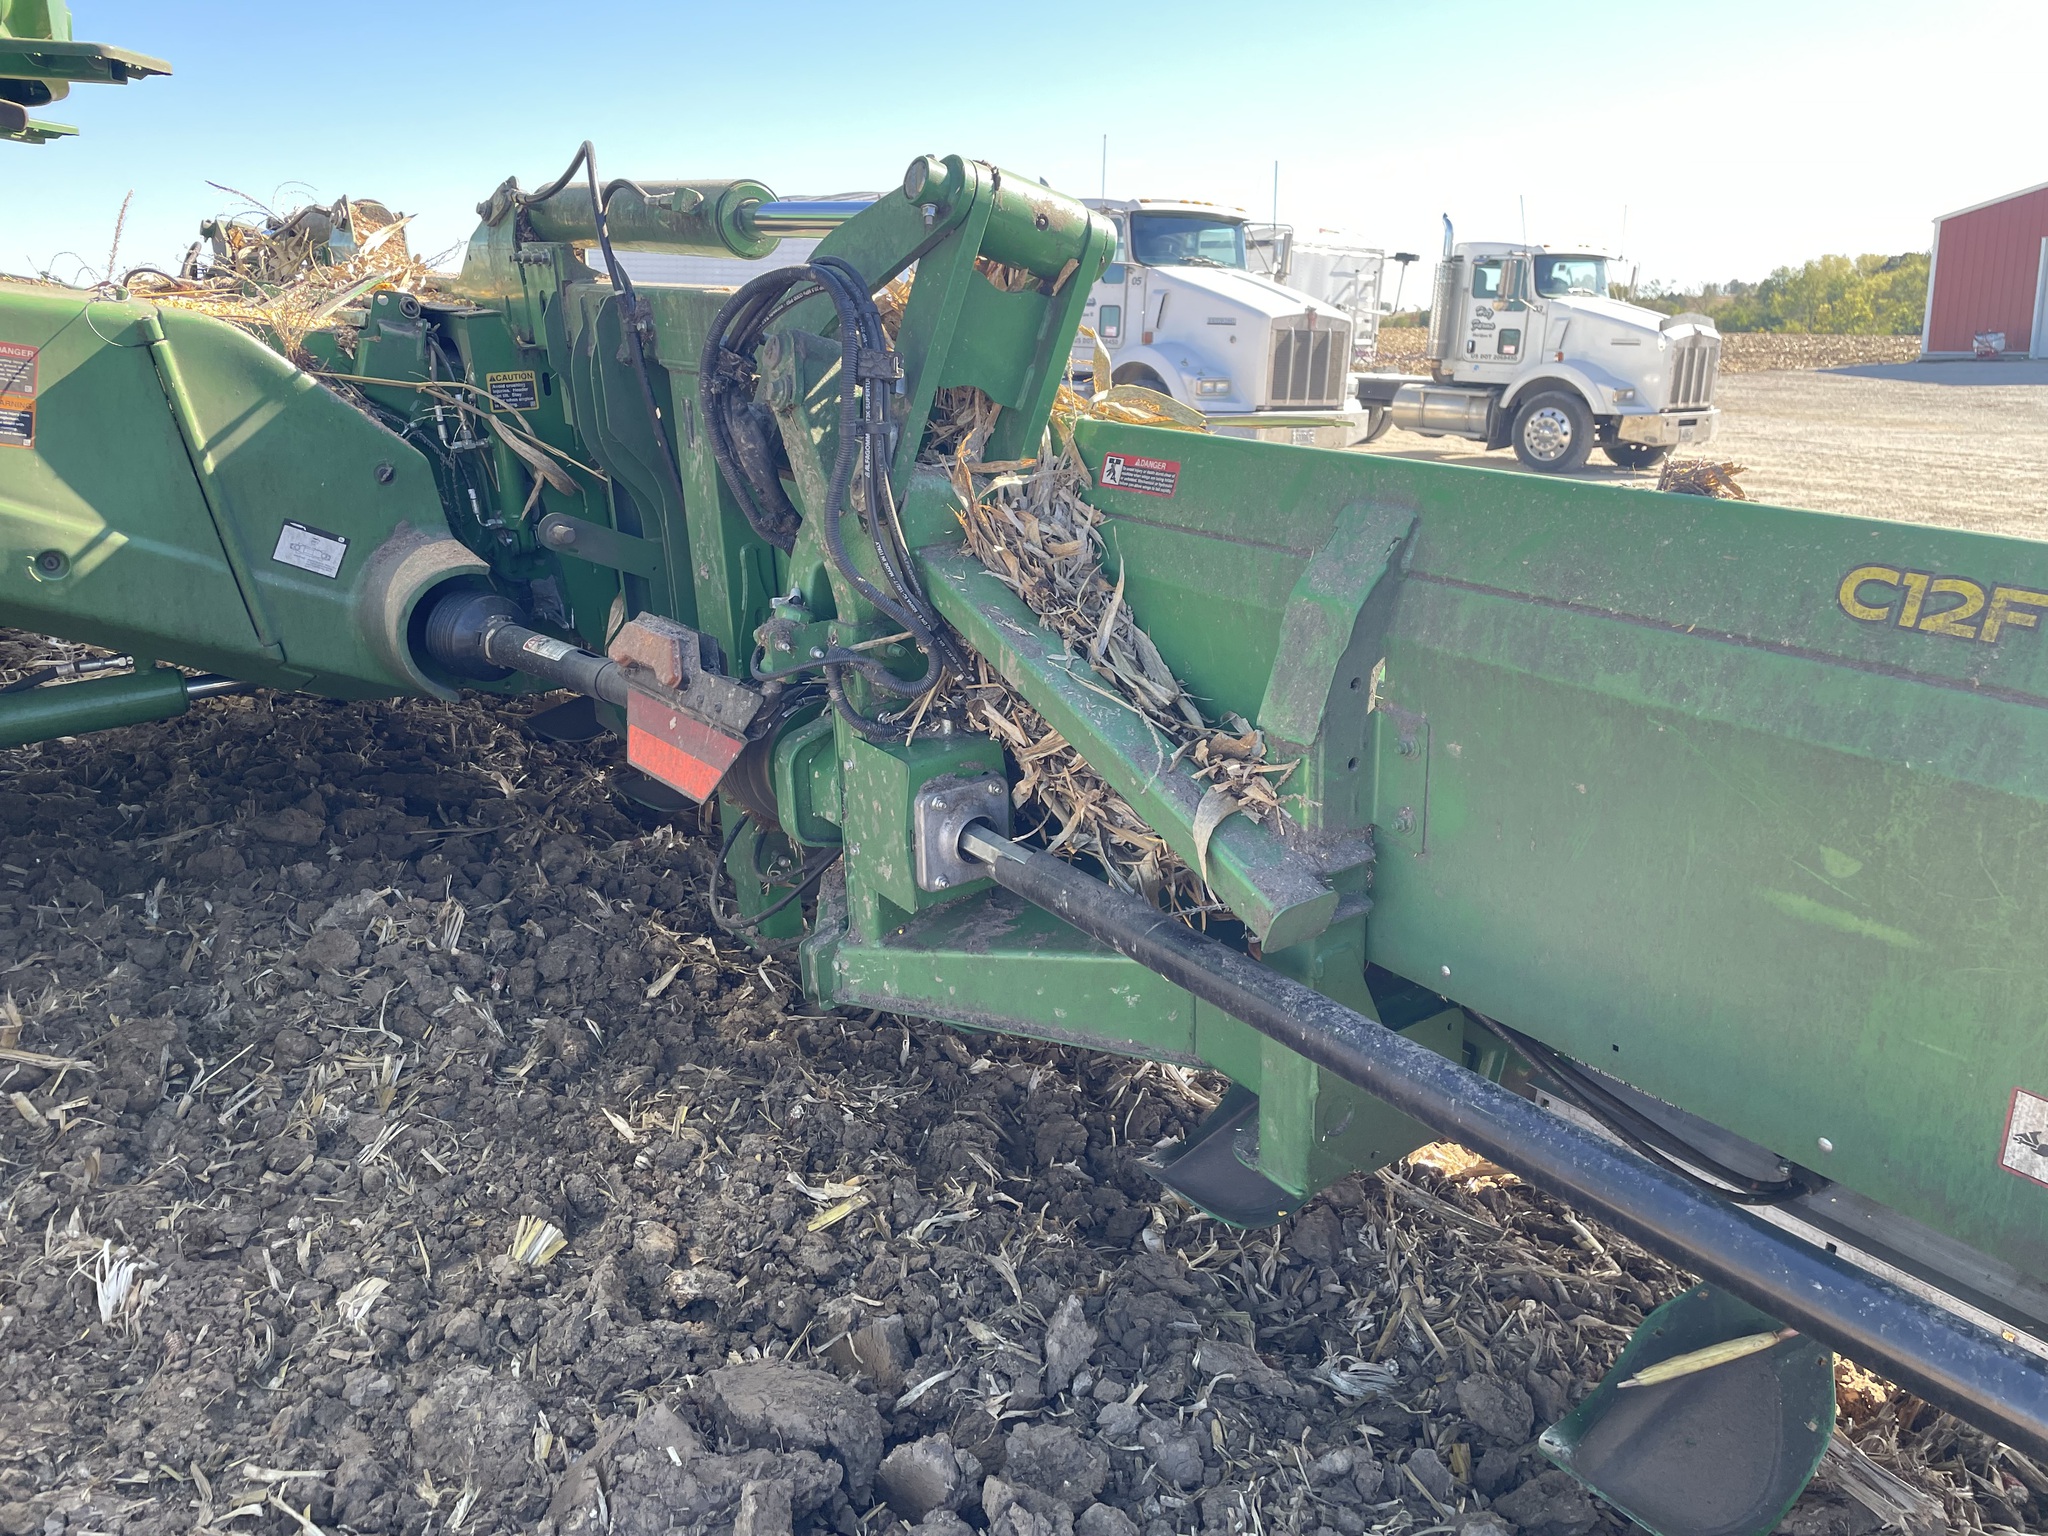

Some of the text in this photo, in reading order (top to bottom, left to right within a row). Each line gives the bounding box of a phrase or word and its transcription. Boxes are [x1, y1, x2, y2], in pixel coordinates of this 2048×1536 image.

[0, 346, 34, 357] ANGER
[496, 372, 533, 381] CAUTION
[0, 400, 32, 410] ARNING
[1140, 460, 1166, 470] DANGER
[875, 542, 884, 556] ITALY
[884, 562, 895, 578] MADE
[1836, 563, 2048, 647] C12F
